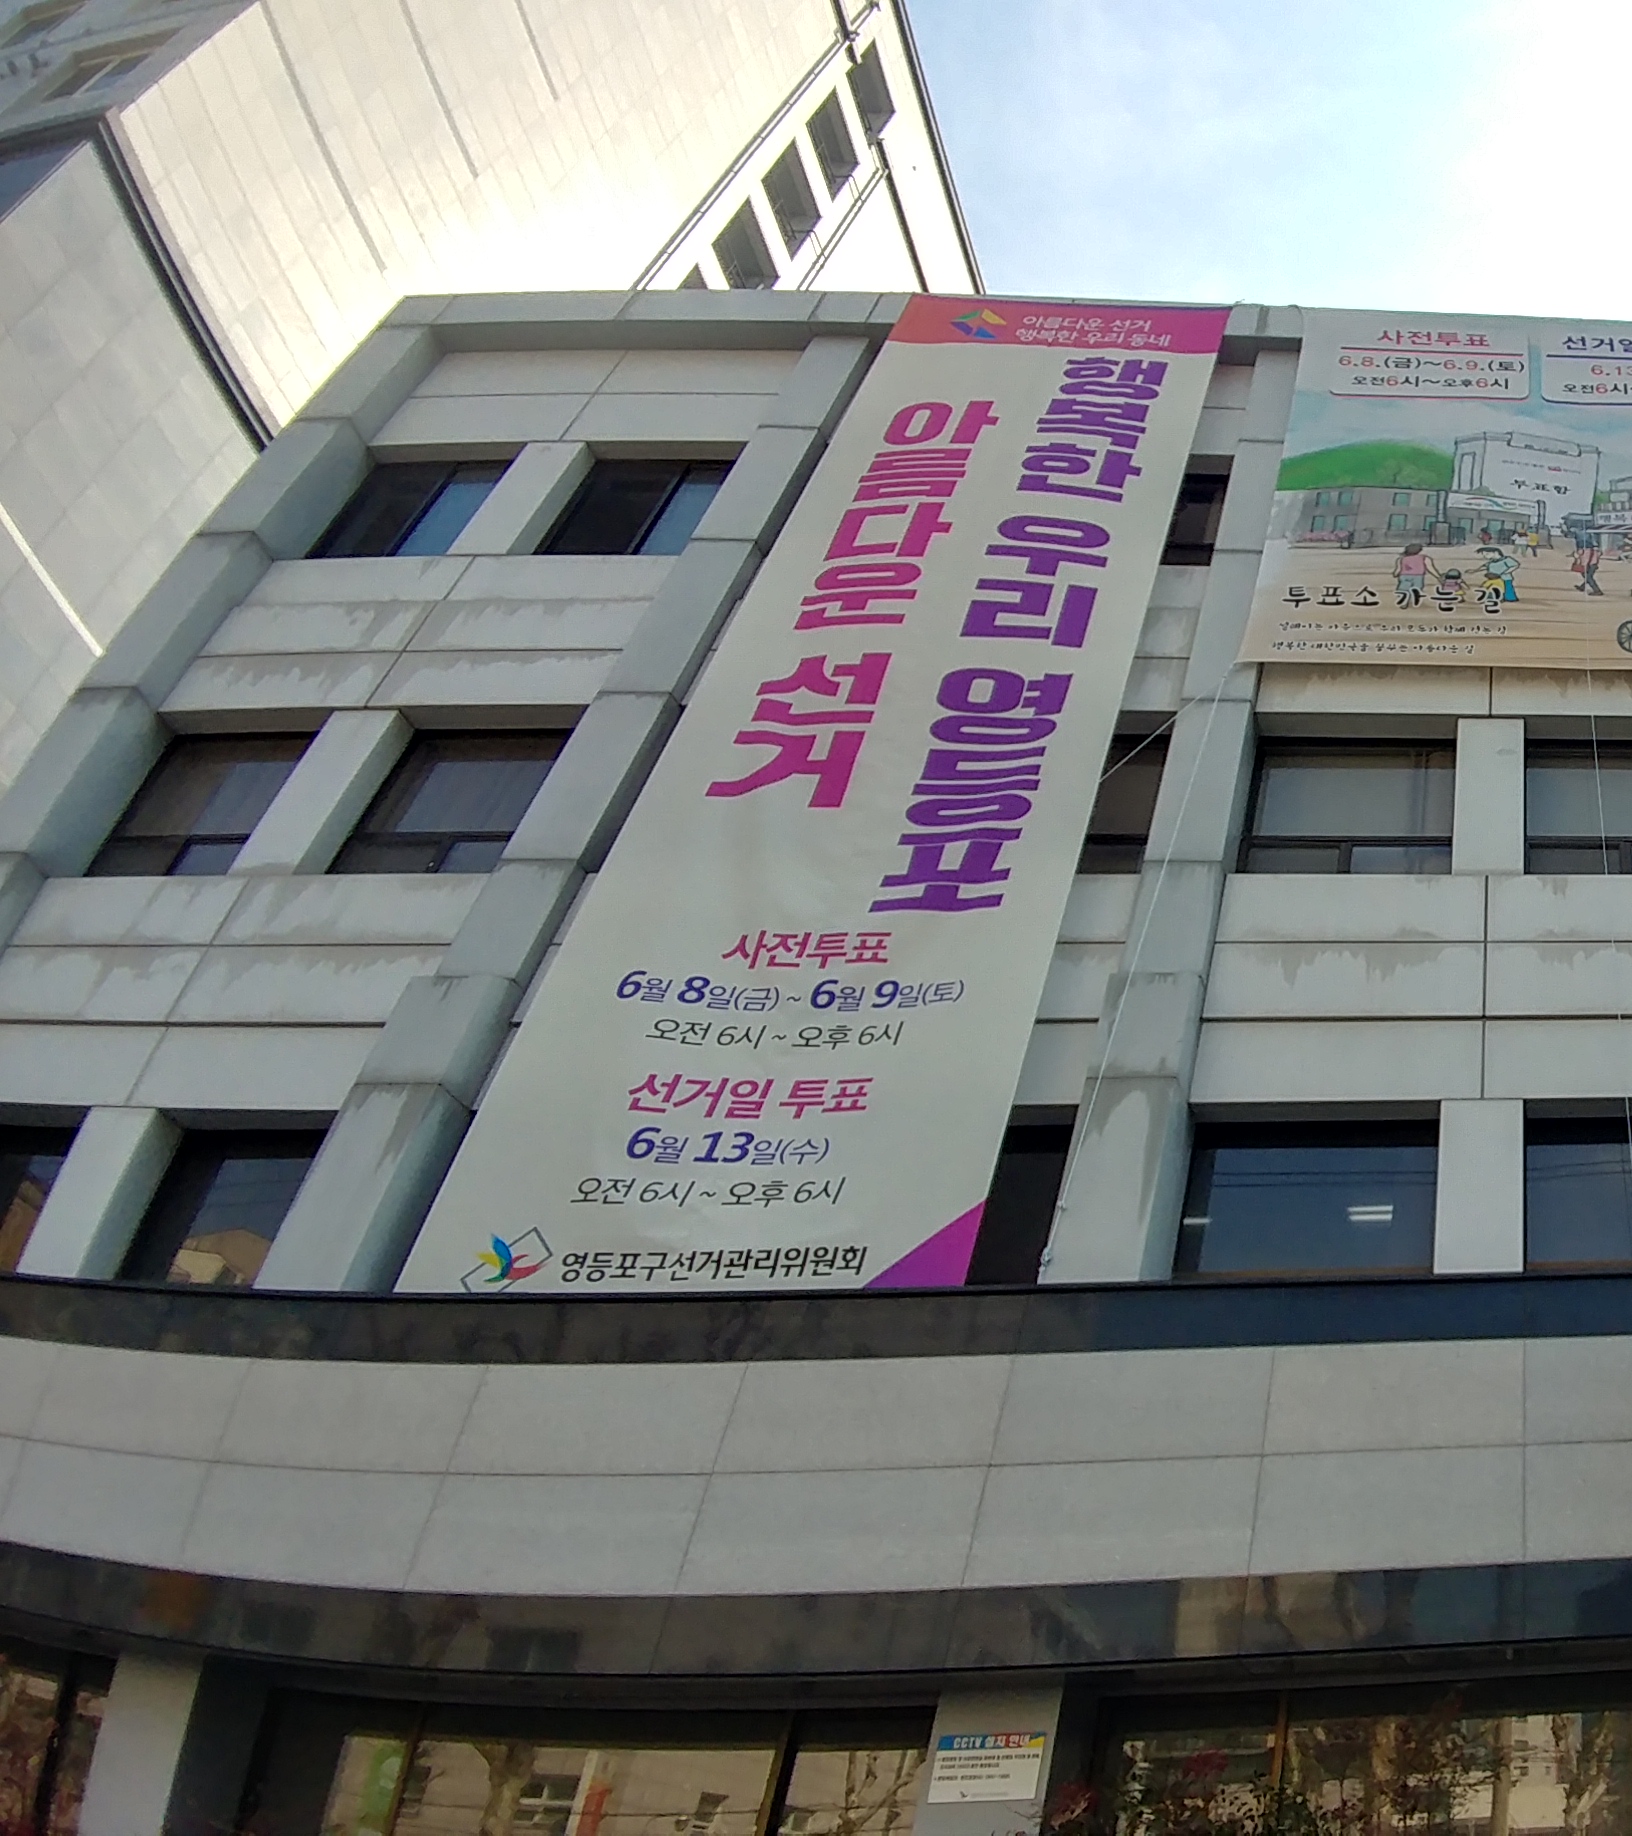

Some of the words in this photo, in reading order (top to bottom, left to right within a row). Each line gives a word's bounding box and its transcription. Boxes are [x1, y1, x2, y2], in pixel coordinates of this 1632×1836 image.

[1014, 328, 1080, 344] 행복한
[1085, 330, 1124, 346] 우리
[1130, 332, 1172, 348] 동네
[1022, 315, 1104, 332] 아름다운
[1109, 318, 1152, 332] 선거
[1376, 329, 1491, 348] 사전투표
[1016, 357, 1169, 503] 행복한
[794, 400, 999, 630] 아름다운
[960, 514, 1110, 649] 우리
[1282, 584, 1380, 608] 투표소
[1394, 587, 1460, 613] 가는
[1475, 588, 1502, 613] 길
[705, 652, 892, 808] 선거
[868, 667, 1073, 914] 영등포
[722, 929, 892, 969] 사전투표
[615, 970, 673, 1003] 6월
[677, 976, 780, 1012] 8일(금)
[809, 979, 866, 1012] 6월
[871, 979, 965, 1010] 9일(토)
[645, 1018, 712, 1048] 오전
[716, 1024, 767, 1050] 6시
[791, 1024, 851, 1050] 오후
[857, 1020, 904, 1047] 6시
[627, 1073, 774, 1120] 선거일
[778, 1077, 874, 1120] 투표
[625, 1127, 689, 1164] 6월
[693, 1130, 830, 1166] 13일(수)
[570, 1176, 637, 1206] 오전
[639, 1179, 694, 1208] 6시
[721, 1179, 787, 1208] 오후
[794, 1176, 846, 1206] 6시
[560, 1246, 869, 1284] 영등포구선거관리위원회
[953, 1736, 983, 1749] CCTV
